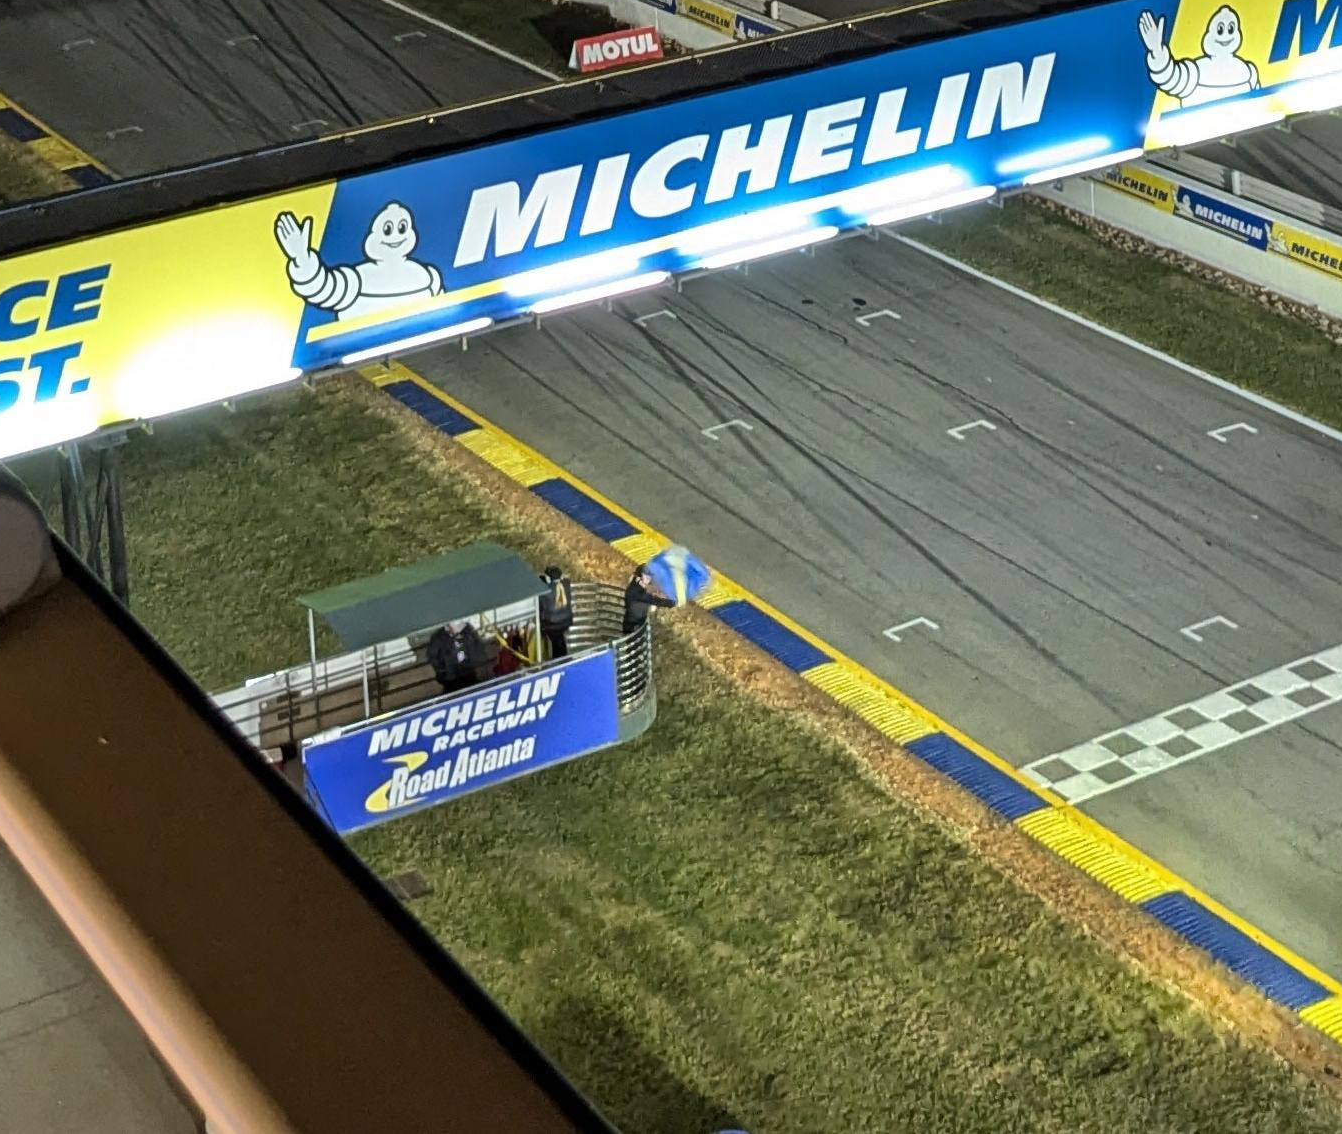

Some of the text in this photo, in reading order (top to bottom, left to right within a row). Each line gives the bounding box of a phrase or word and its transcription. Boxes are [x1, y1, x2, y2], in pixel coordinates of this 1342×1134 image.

[688, 4, 731, 29] MICHELIN
[582, 32, 659, 65] MOTUL
[453, 52, 1057, 269] MICHELIN
[1106, 171, 1169, 203] MICHELIN
[1194, 203, 1264, 240] MICHELIN
[368, 671, 563, 757] MICHELIN
[432, 700, 554, 754] RACEWAY
[388, 736, 536, 809] Road Atlanta
